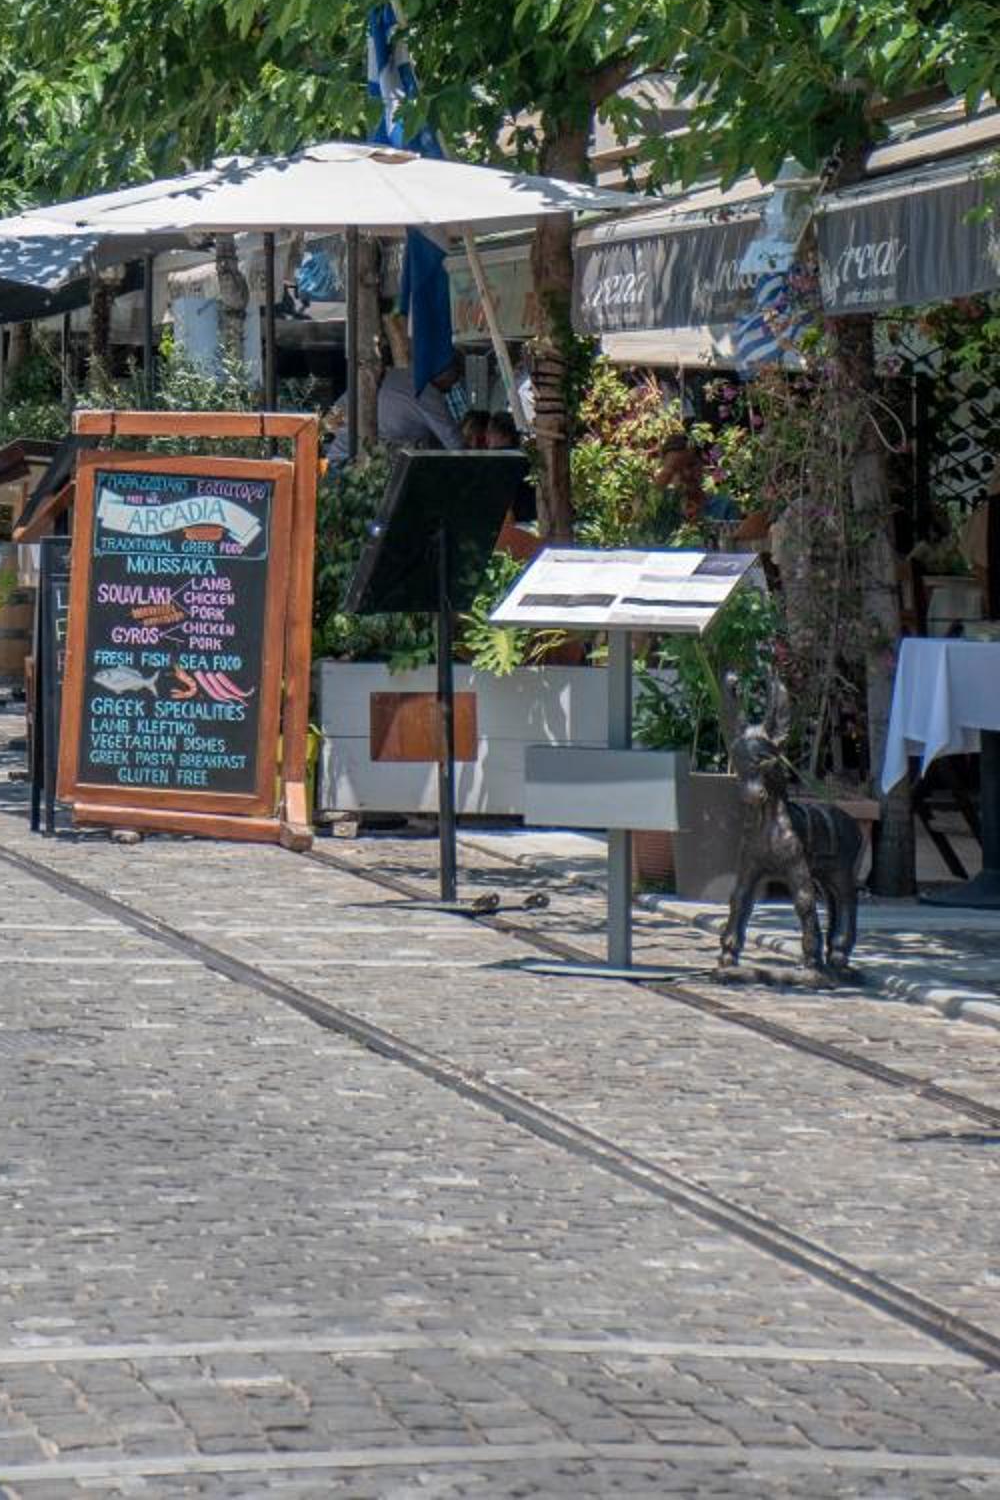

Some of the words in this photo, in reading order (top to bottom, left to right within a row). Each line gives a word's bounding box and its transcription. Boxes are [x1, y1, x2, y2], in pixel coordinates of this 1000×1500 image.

[127, 500, 227, 533] ARCADIA
[101, 537, 174, 553] TRADITIONAL
[181, 541, 216, 555] GREEK
[127, 556, 217, 575] MOUSSAKA
[191, 577, 233, 591] LAMB
[97, 583, 172, 605] SOUVLAKI
[183, 591, 235, 606] CHICKEN
[190, 605, 225, 620] PORK
[111, 627, 160, 645] GYROS
[182, 622, 235, 636] CHICKEN
[189, 637, 223, 651] PORK
[93, 651, 133, 666] FRESH
[141, 653, 170, 668] FISH
[179, 654, 208, 670] SEA
[213, 655, 242, 671] FOOD
[91, 698, 145, 717] GREEK
[154, 700, 246, 721] SPECIALITIES
[91, 718, 129, 733] LAMB
[137, 719, 196, 736] KLEFTIKO
[90, 734, 177, 750] VEGETARIAN
[184, 737, 226, 753] DISHES
[89, 750, 129, 765] GREEK
[136, 752, 175, 766] PASTA
[179, 754, 247, 769] BREAKFAST
[118, 768, 169, 784] GLUTEN
[177, 769, 209, 785] FREE
